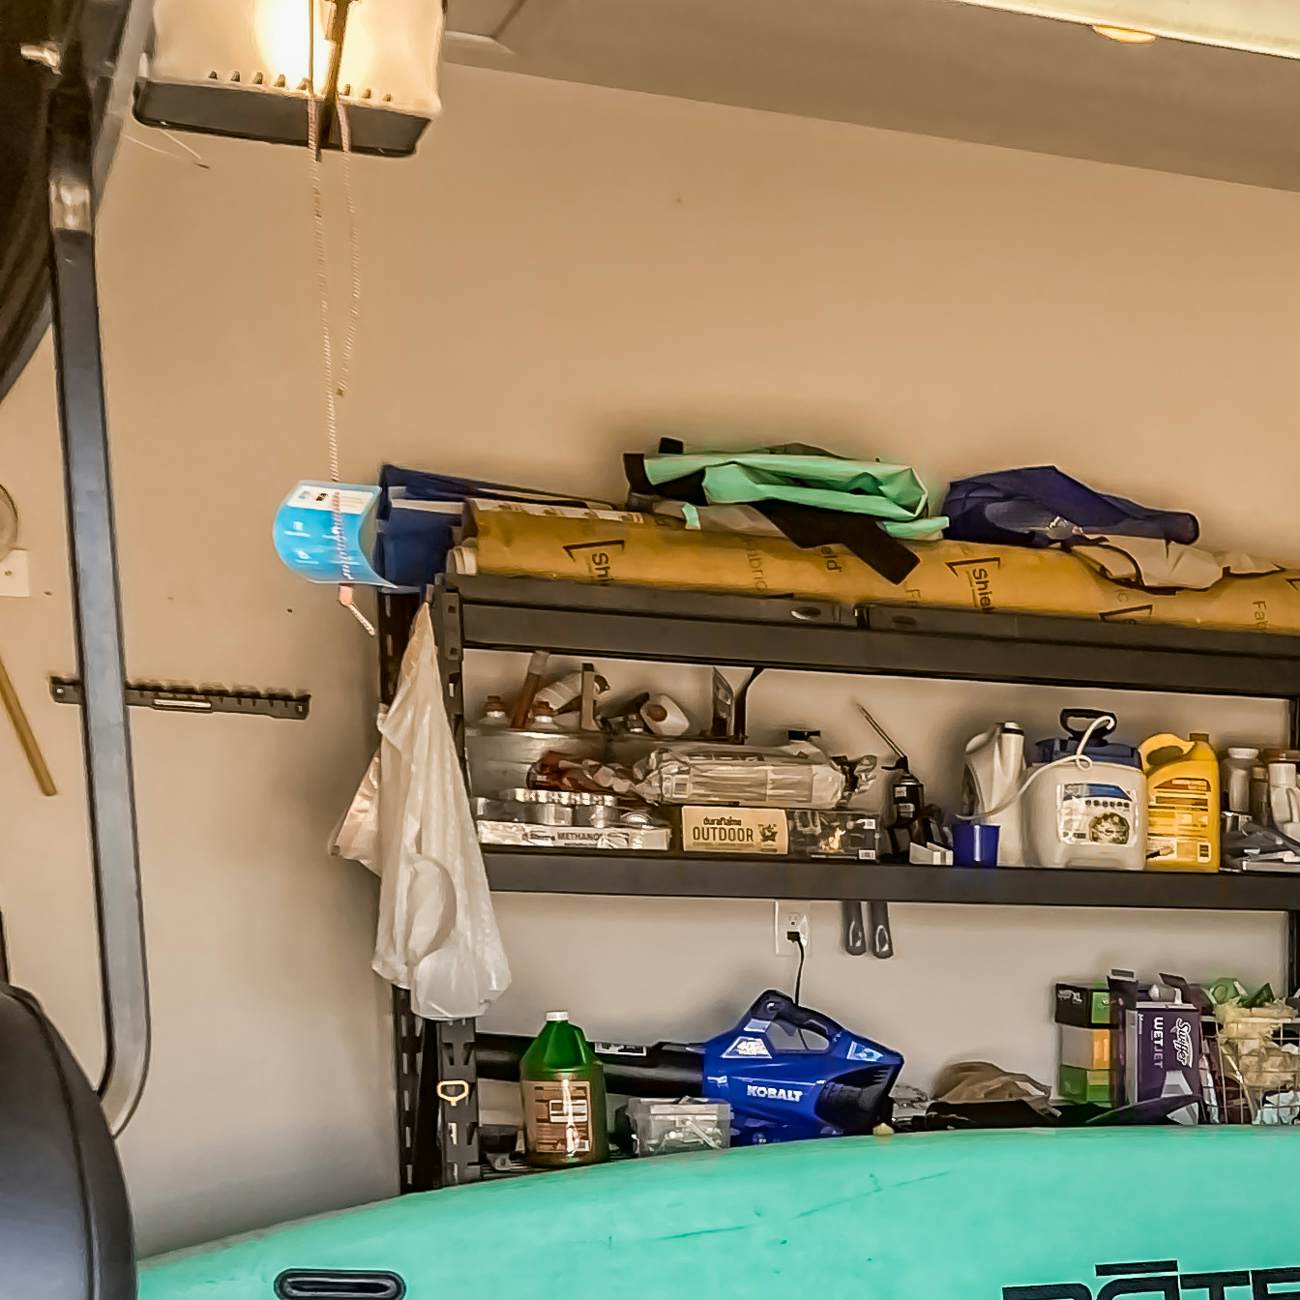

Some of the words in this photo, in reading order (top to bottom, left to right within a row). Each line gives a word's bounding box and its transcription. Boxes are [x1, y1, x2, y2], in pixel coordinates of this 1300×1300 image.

[972, 568, 995, 612] Shiel
[693, 826, 754, 842] OUTDOOR
[1153, 1016, 1164, 1069] WETJET
[1173, 1017, 1193, 1068] Swiffer
[747, 1084, 803, 1103] KOBALT
